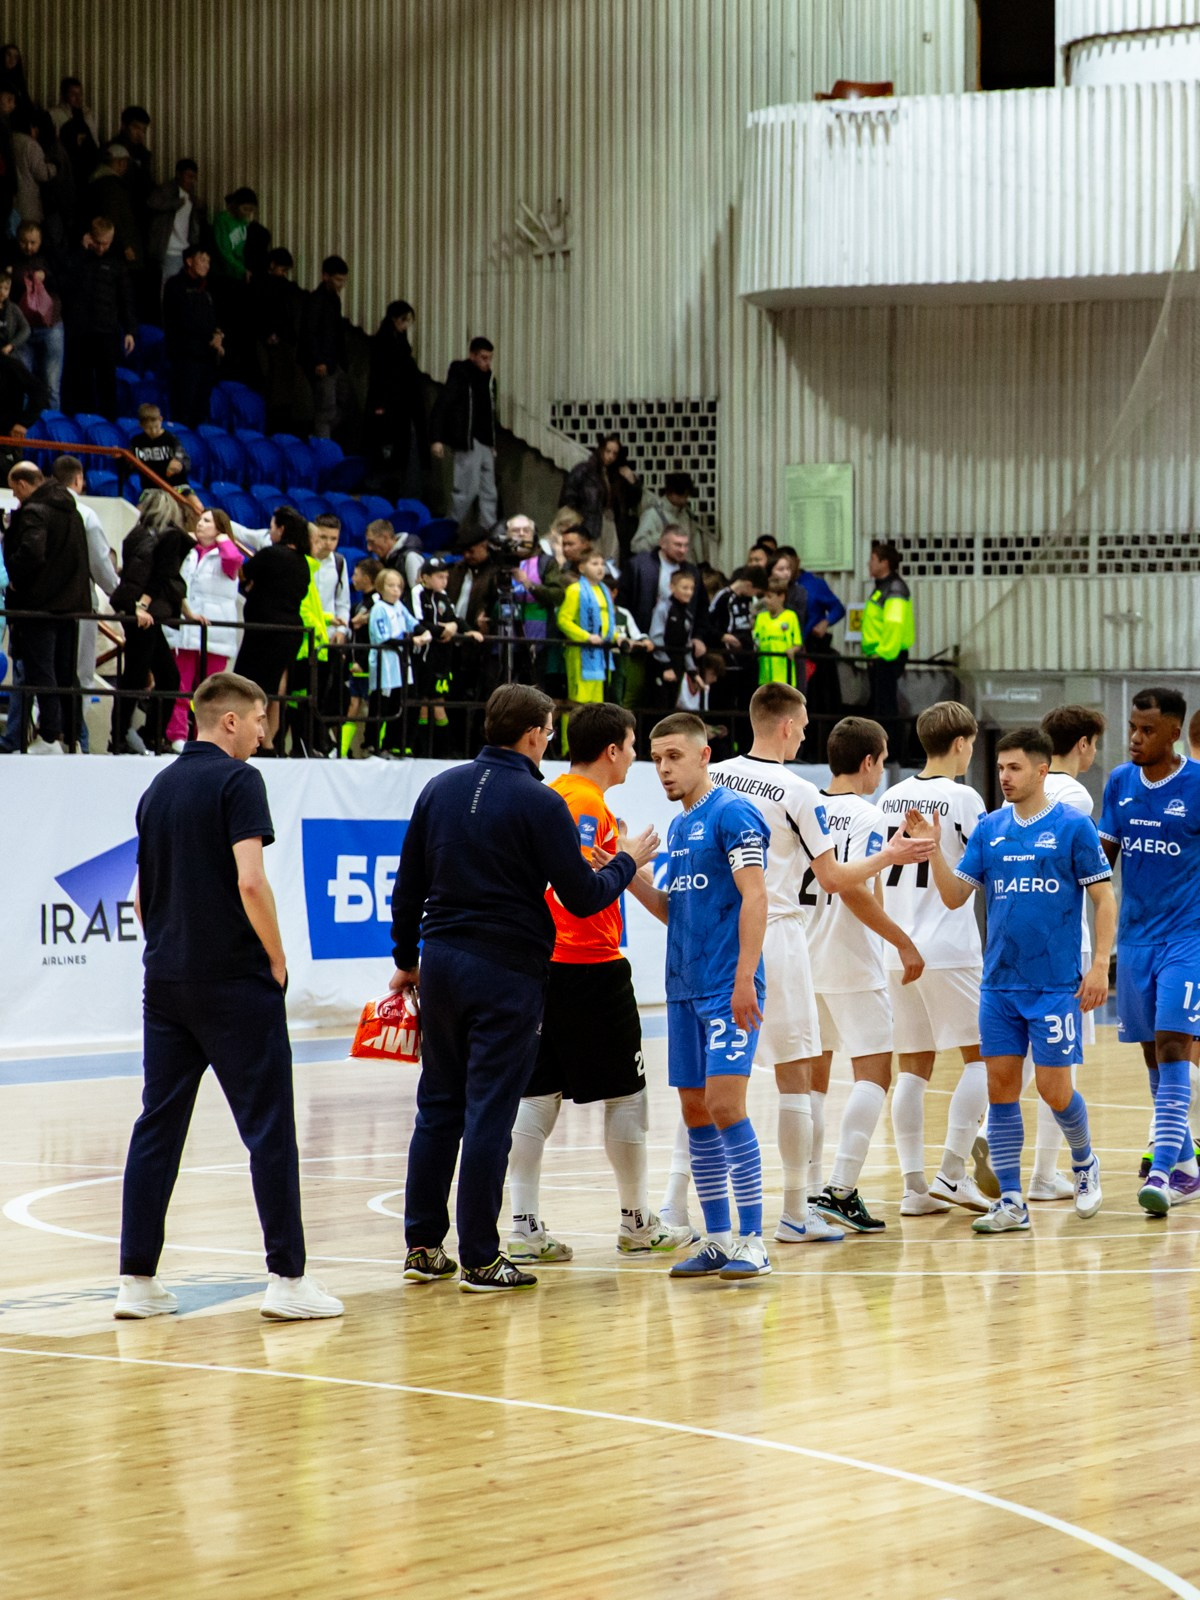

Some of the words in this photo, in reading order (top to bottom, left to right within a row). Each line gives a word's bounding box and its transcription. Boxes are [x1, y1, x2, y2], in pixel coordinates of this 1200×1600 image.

[327, 854, 401, 923] БЕ
[668, 873, 709, 894] AERO
[994, 877, 1060, 893] IRAERO
[41, 898, 138, 945] IRAE
[42, 955, 87, 966] AIRLINES
[1045, 1013, 1076, 1044] 30
